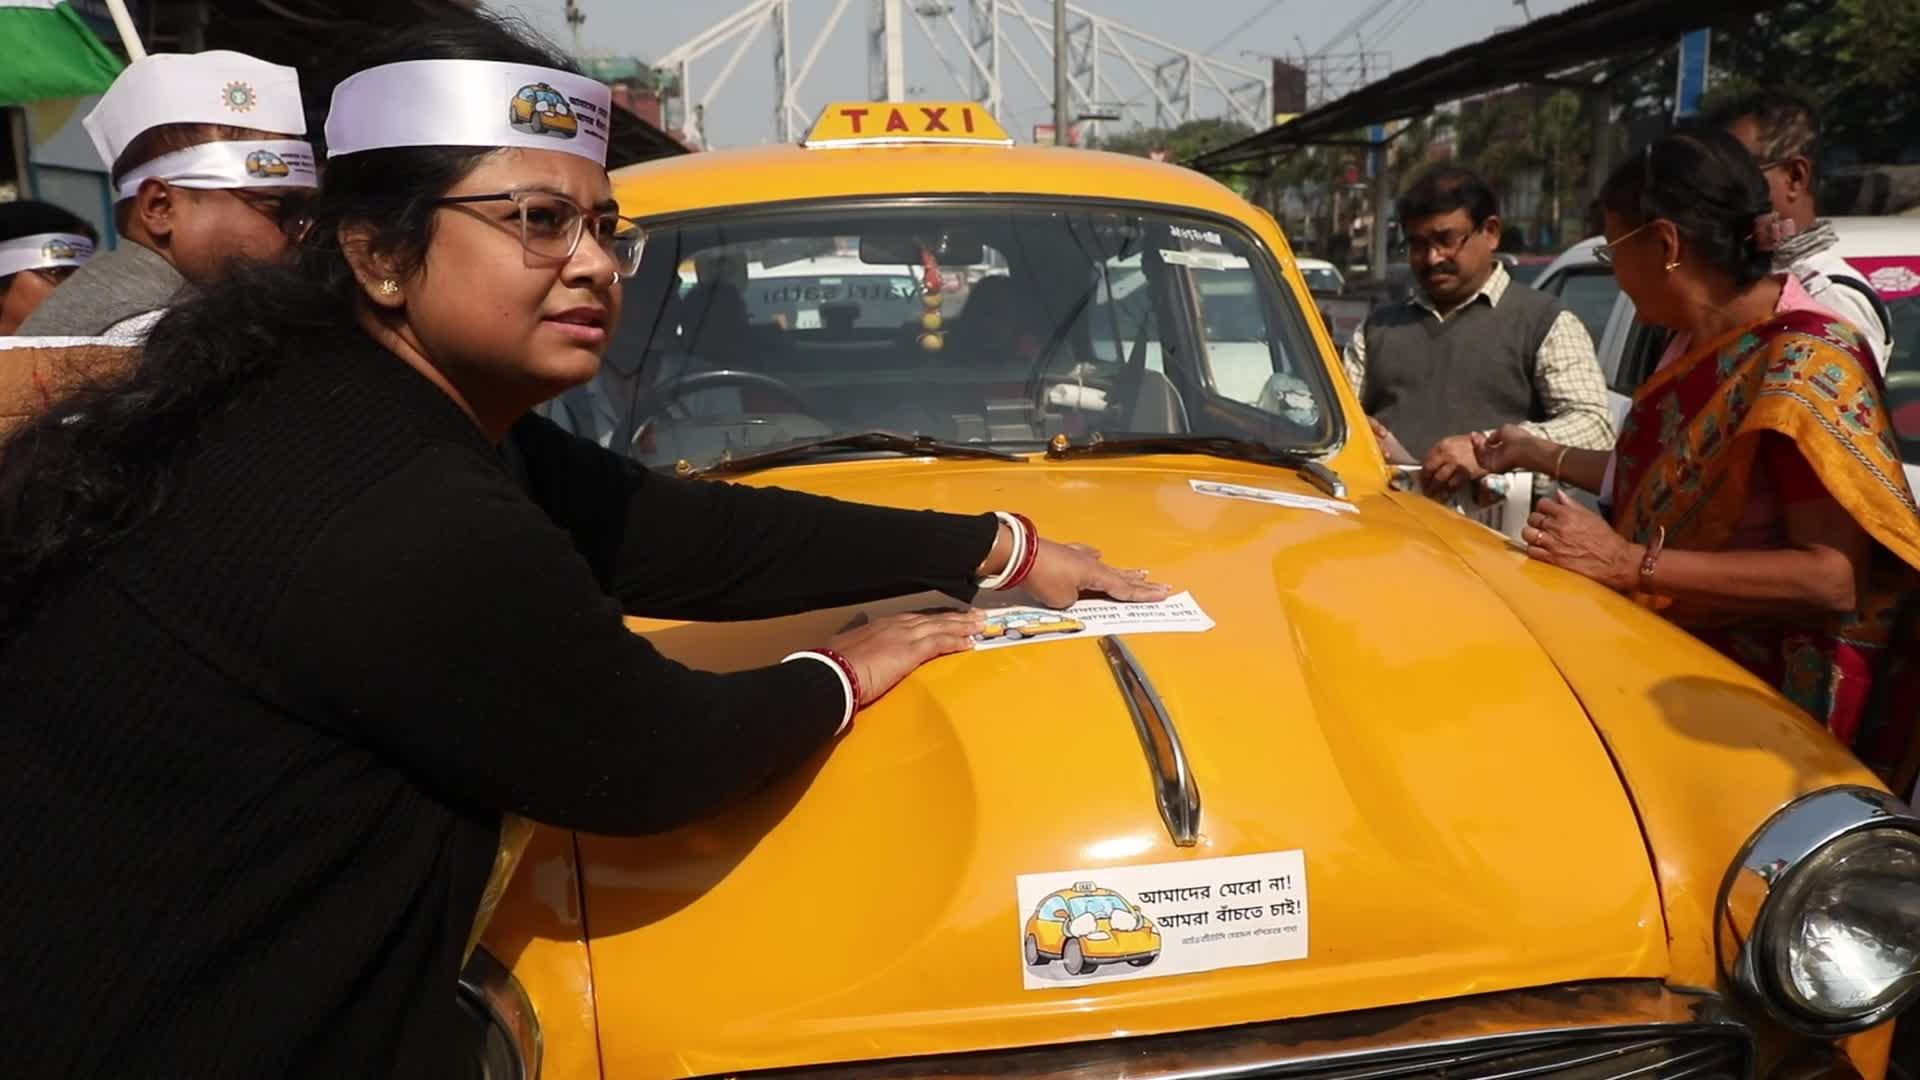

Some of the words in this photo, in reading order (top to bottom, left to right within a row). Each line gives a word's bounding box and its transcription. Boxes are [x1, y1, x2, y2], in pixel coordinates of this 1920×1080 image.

[841, 108, 974, 133] TAXI
[1138, 885, 1211, 904] আমাদের
[1219, 879, 1262, 897] মেরো
[1268, 875, 1291, 891] না!
[1157, 911, 1209, 928] আমরা
[1216, 905, 1263, 922] বাঁচতে
[1270, 898, 1301, 917] চাই!
